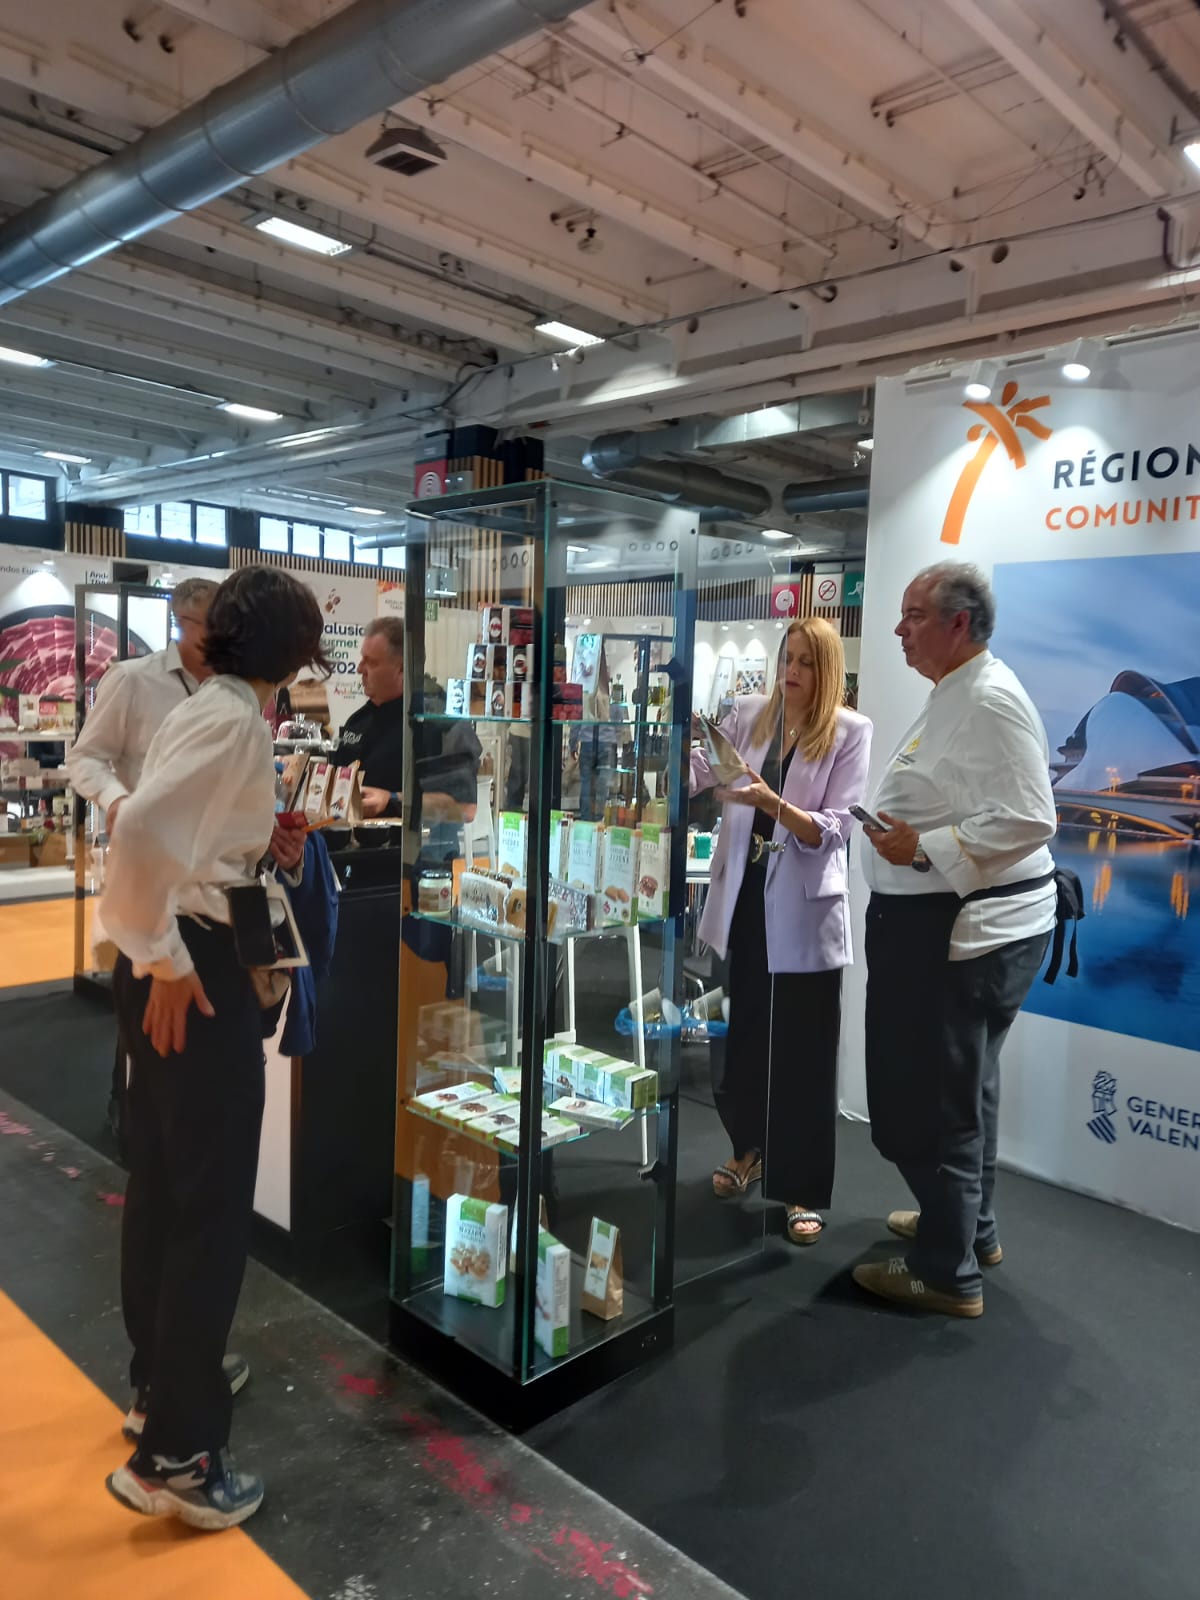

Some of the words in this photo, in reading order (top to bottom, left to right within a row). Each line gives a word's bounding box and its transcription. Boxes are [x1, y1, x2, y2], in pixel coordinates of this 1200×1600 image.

[1053, 443, 1200, 489] RÉGION
[1045, 495, 1200, 531] COMUNIT
[1127, 1096, 1200, 1129] GENER
[1128, 1116, 1199, 1151] VALEN
